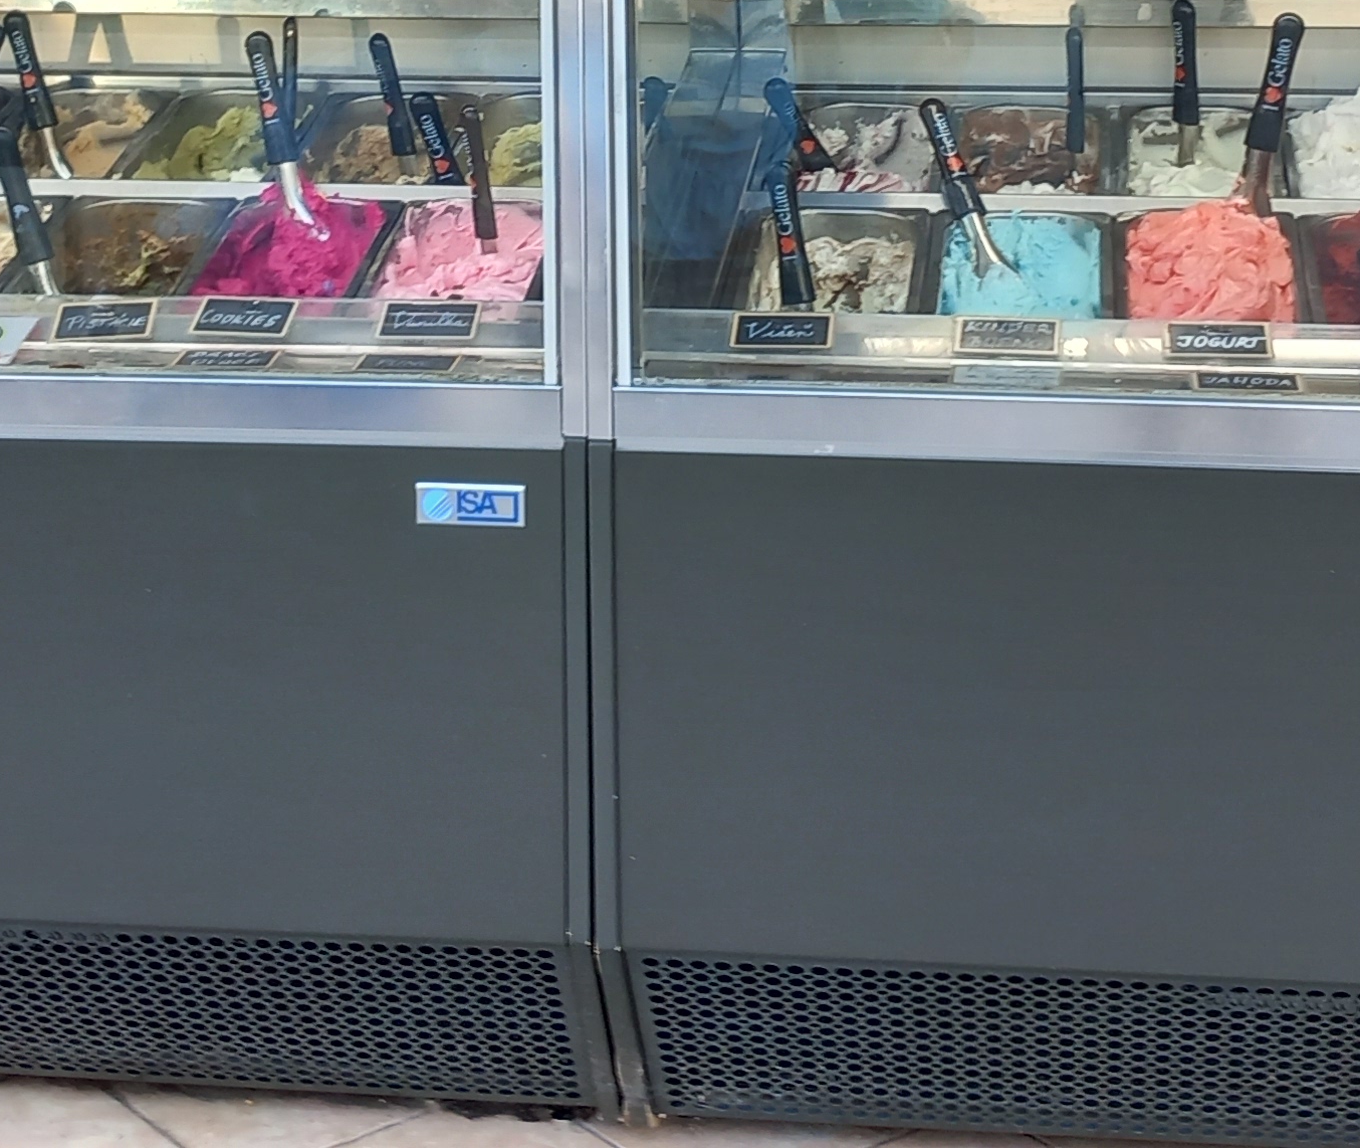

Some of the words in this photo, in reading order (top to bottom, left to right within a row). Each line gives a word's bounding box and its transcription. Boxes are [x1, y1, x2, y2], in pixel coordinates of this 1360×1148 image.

[251, 52, 275, 102] Gelato
[1267, 37, 1294, 88] Gelato
[419, 113, 445, 159] Gelato
[776, 183, 796, 236] Gelato
[199, 309, 283, 328] COOKIES
[1175, 335, 1267, 349] JOGURT
[1204, 374, 1293, 388] JAHODA
[456, 490, 497, 515] ISA
